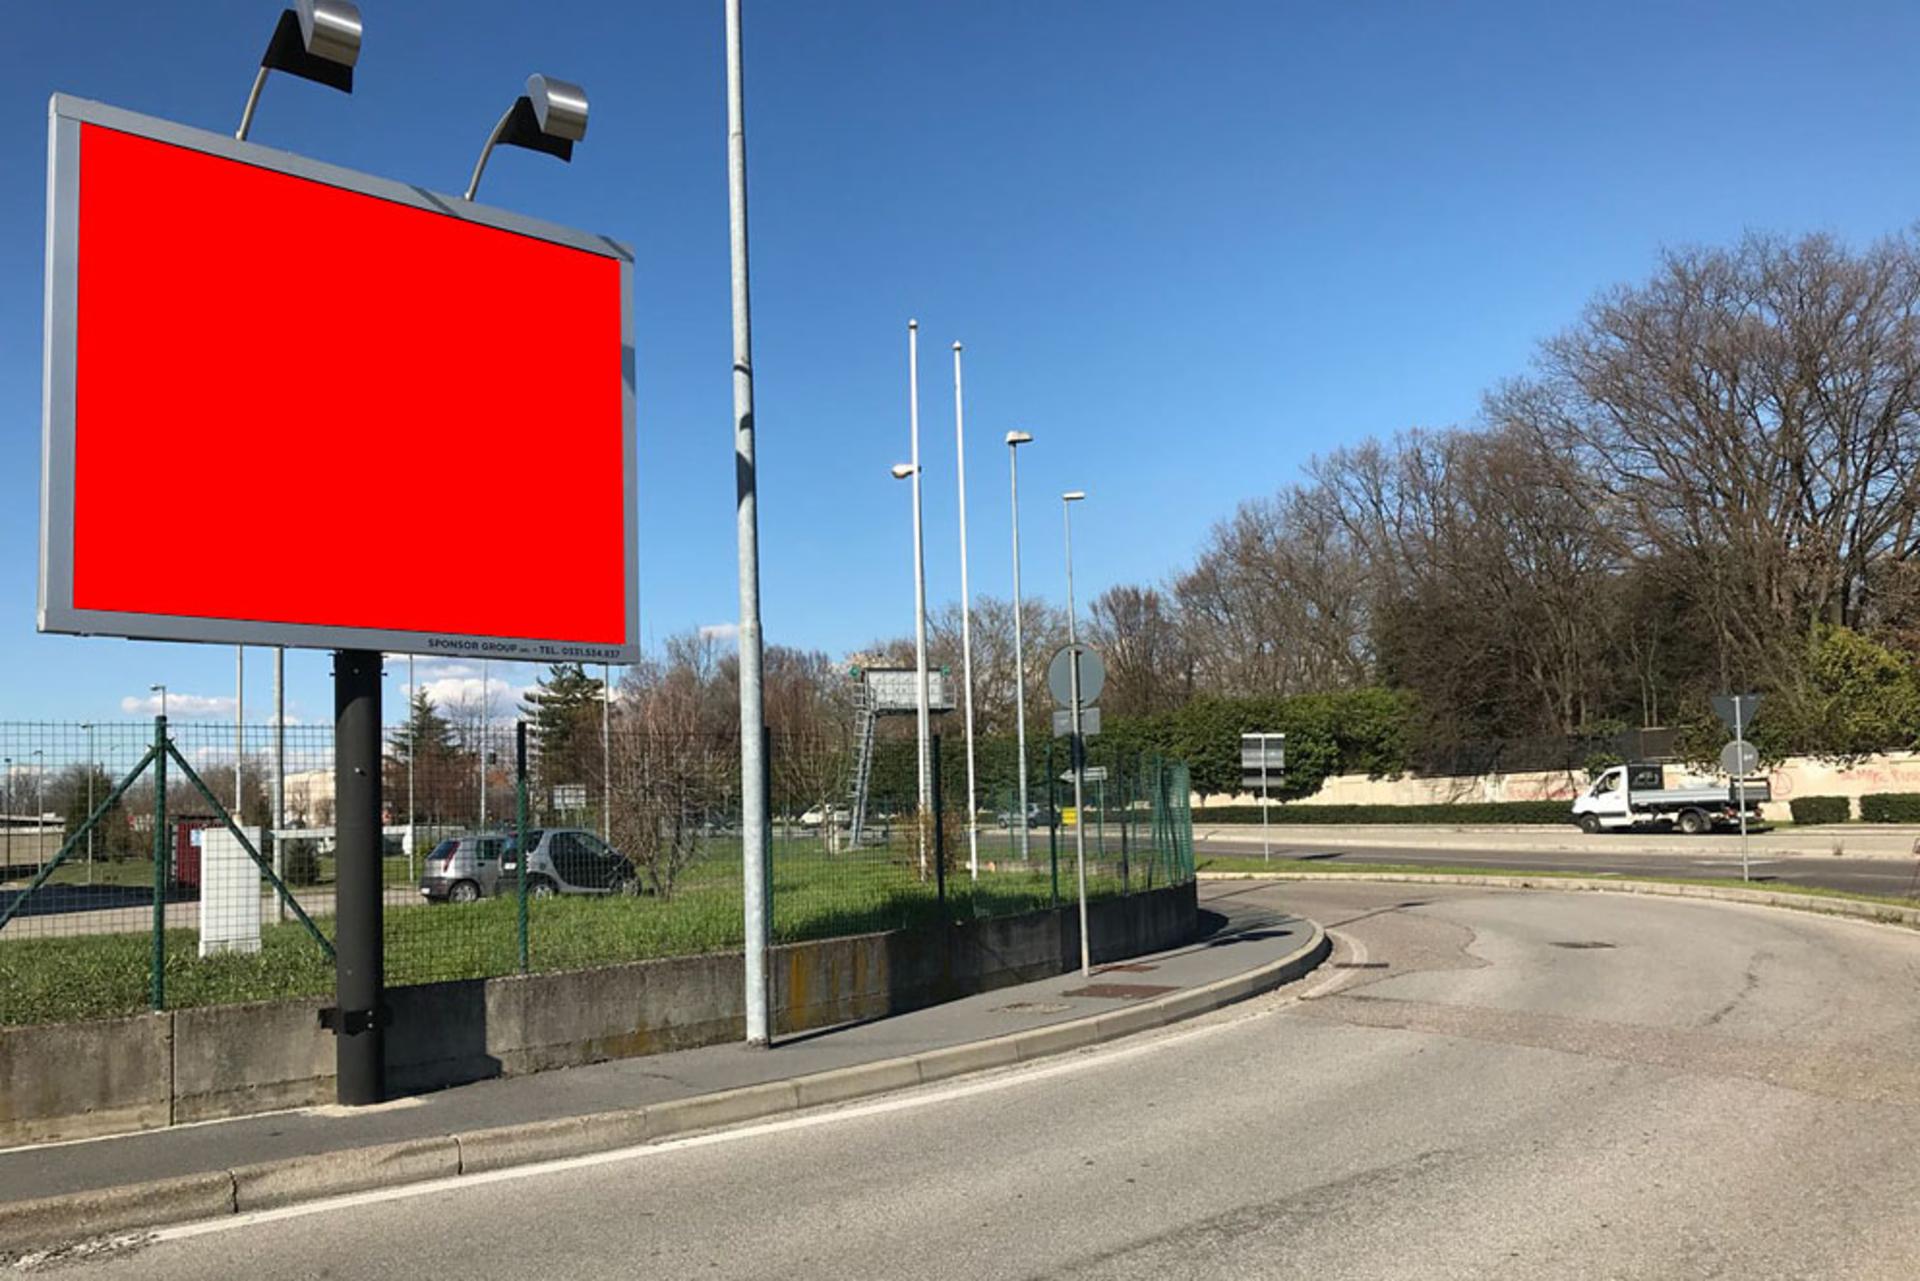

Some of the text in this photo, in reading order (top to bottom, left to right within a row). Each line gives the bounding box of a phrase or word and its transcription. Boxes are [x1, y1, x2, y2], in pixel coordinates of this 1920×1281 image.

[428, 639, 479, 649] SPONSOR
[482, 642, 517, 653] GROUP
[539, 646, 559, 655] TEL.
